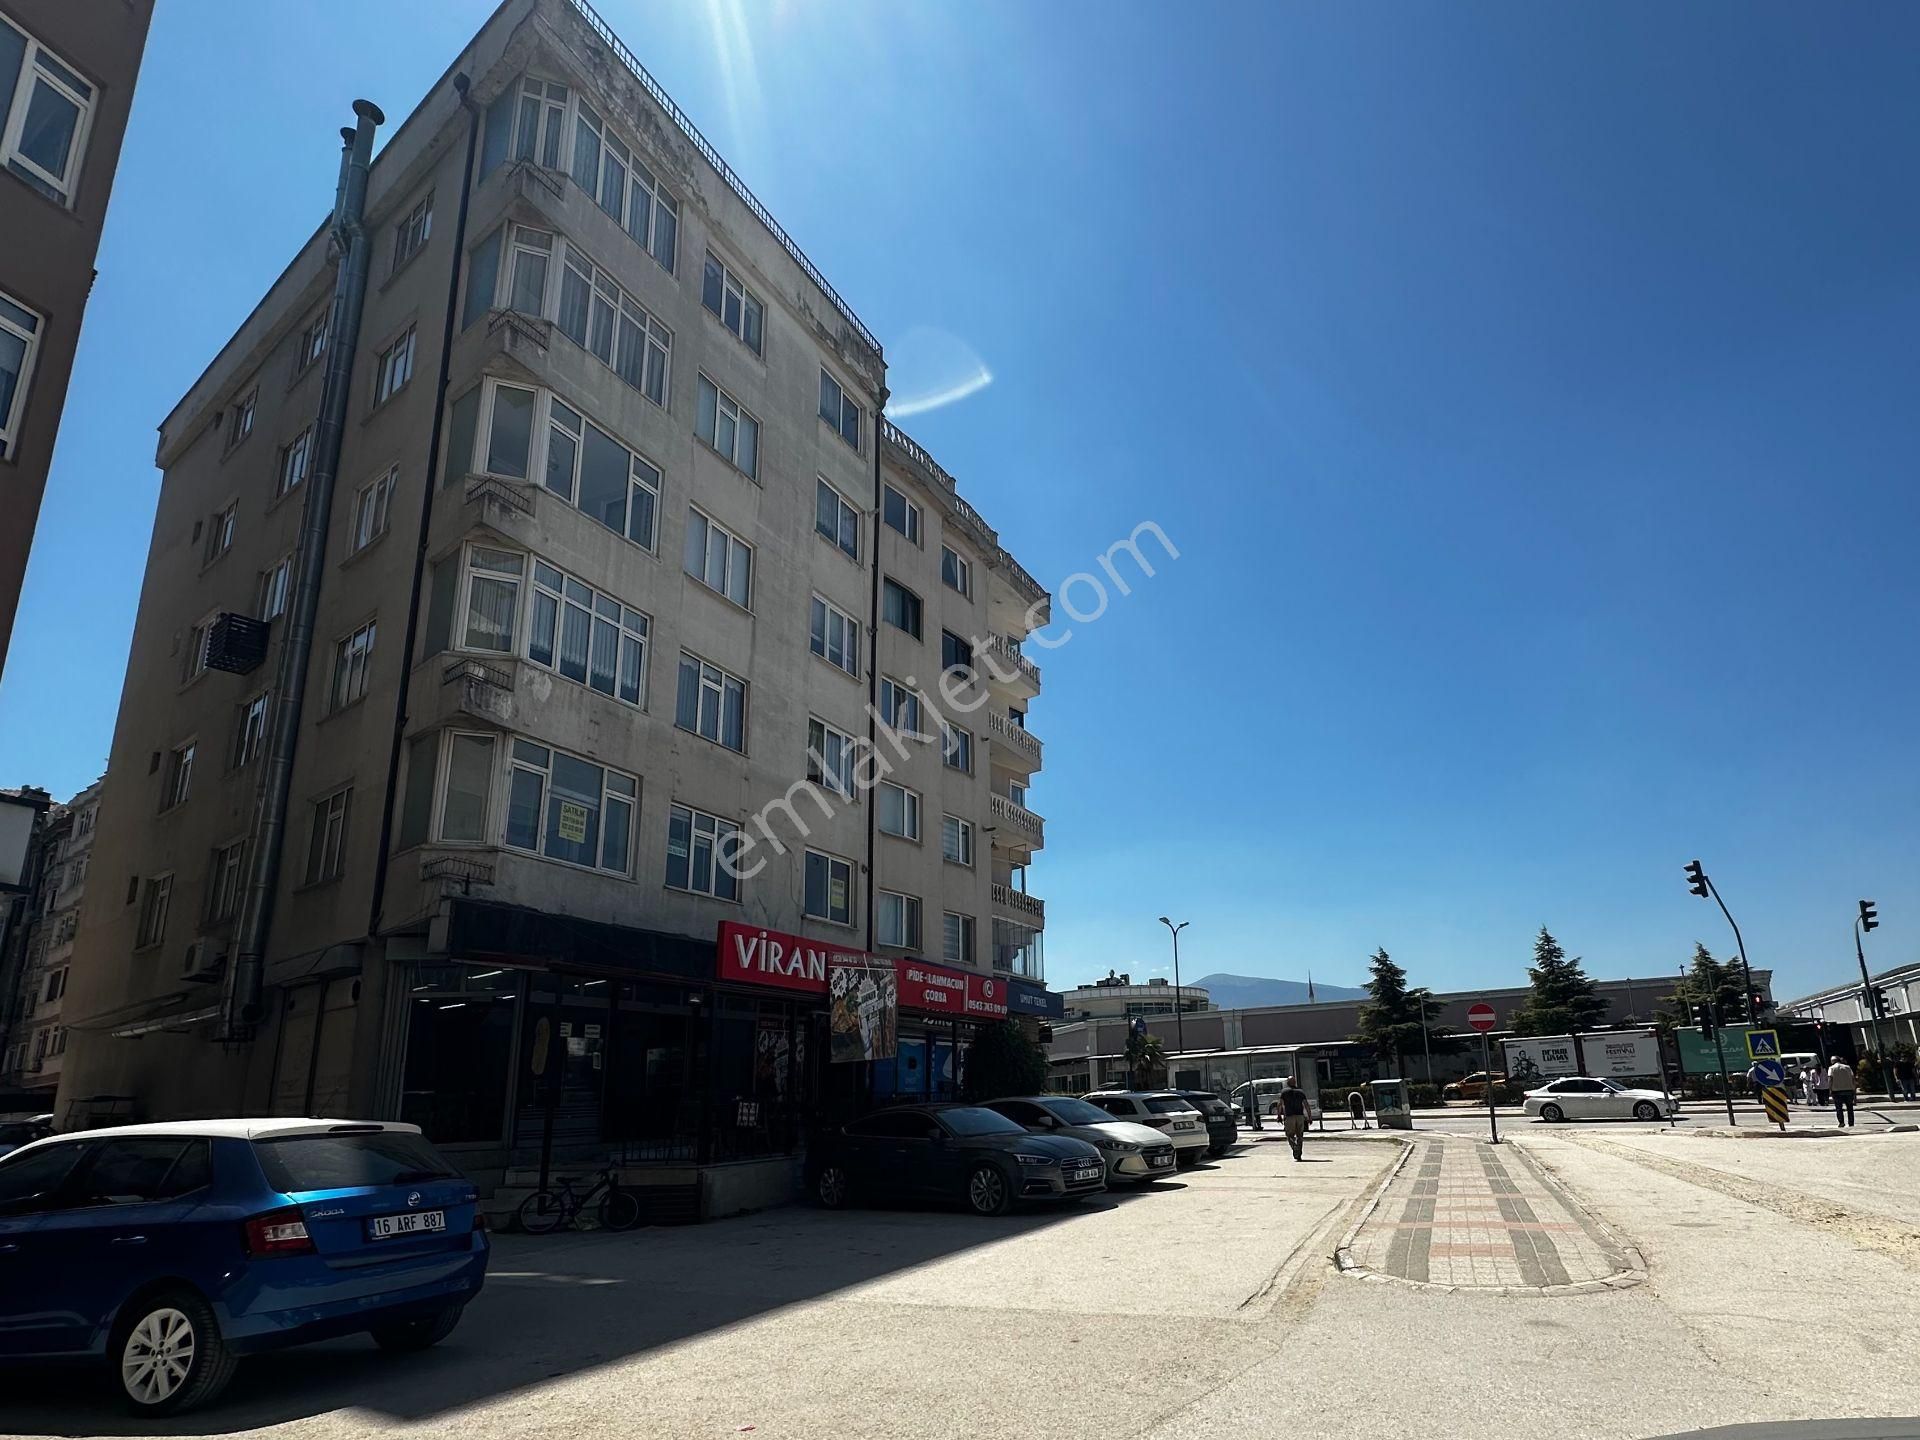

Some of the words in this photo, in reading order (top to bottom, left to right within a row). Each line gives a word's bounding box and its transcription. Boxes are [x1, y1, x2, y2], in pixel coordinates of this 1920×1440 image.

[734, 931, 826, 982] VİRAN
[923, 989, 947, 1003] ÇORBA
[376, 1219, 391, 1234] 16
[397, 1216, 416, 1232] ARF
[423, 1213, 442, 1228] 887
